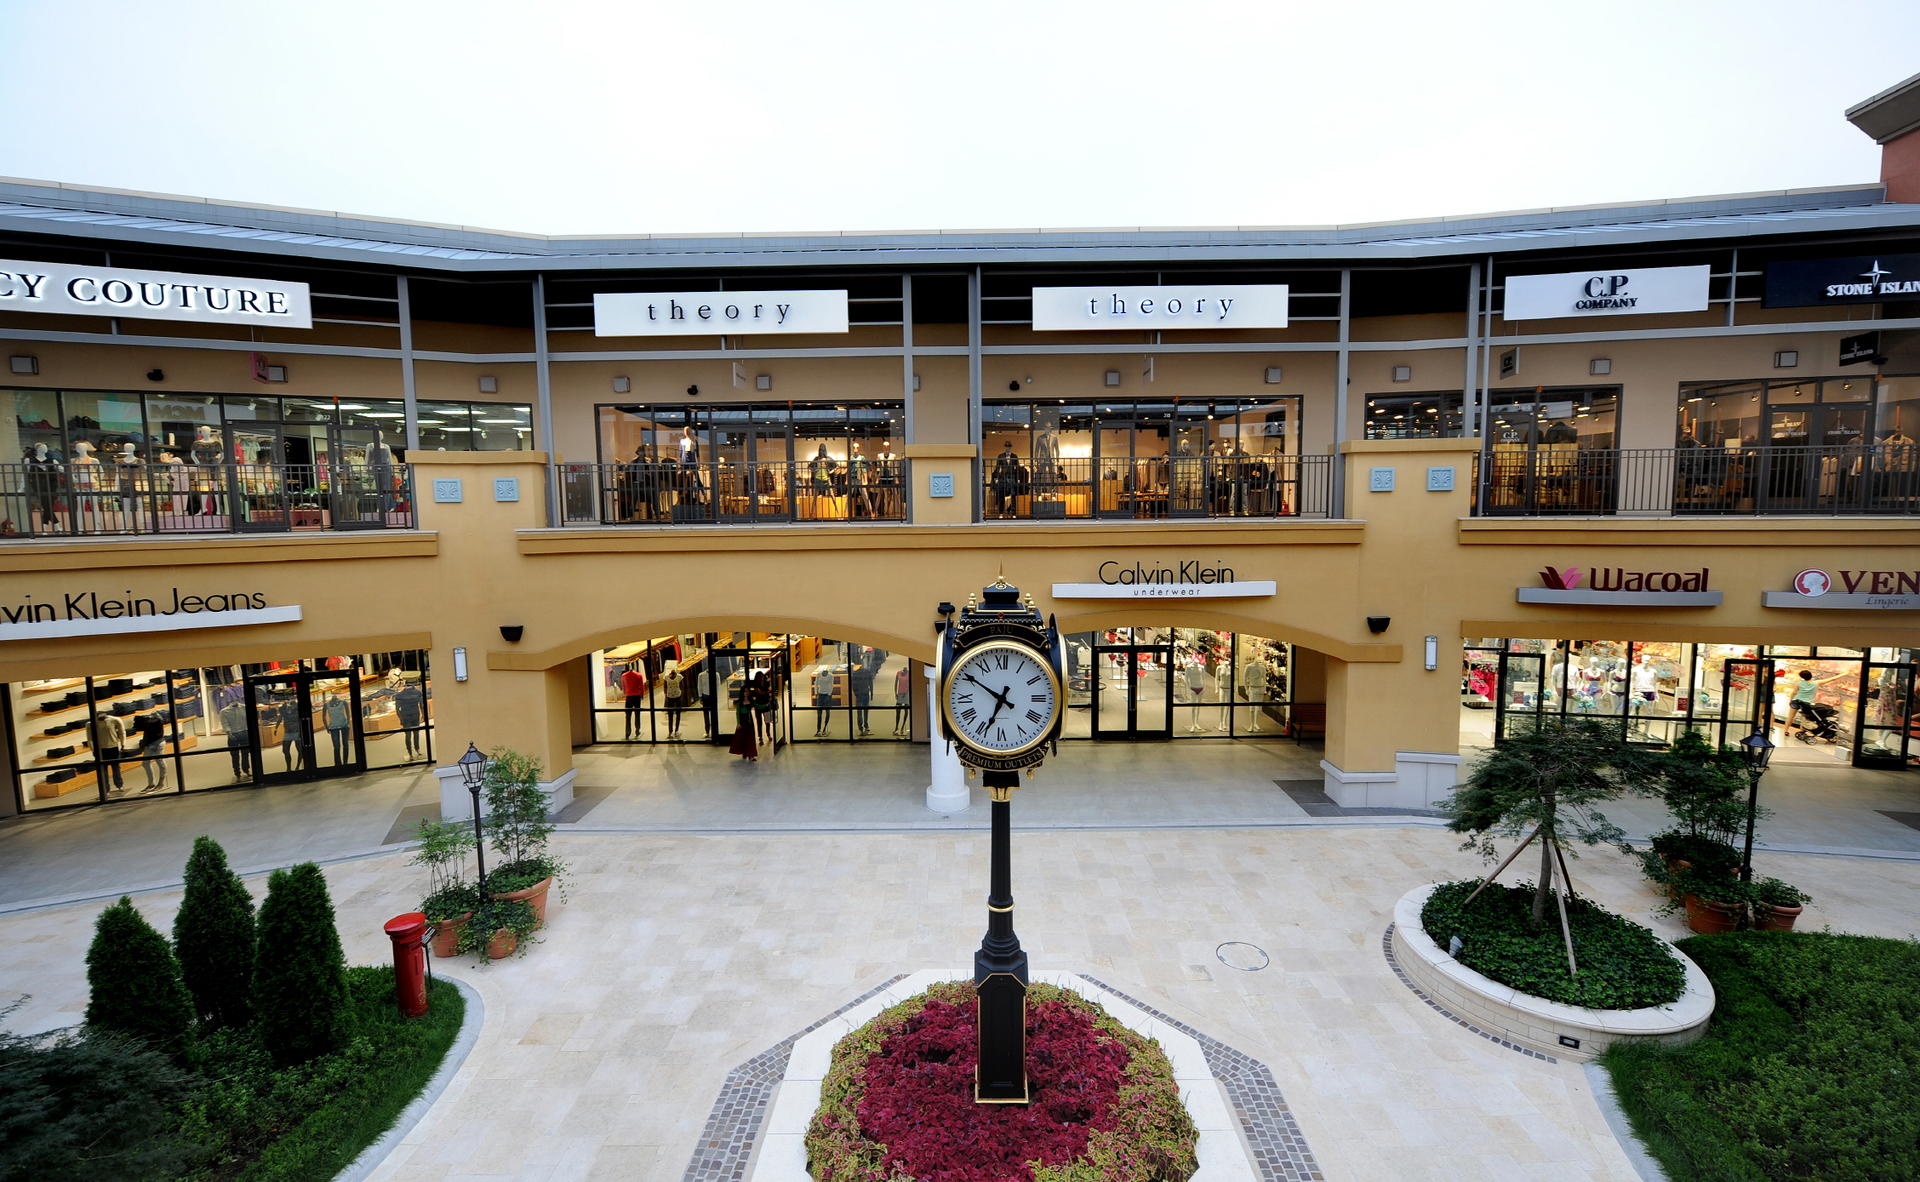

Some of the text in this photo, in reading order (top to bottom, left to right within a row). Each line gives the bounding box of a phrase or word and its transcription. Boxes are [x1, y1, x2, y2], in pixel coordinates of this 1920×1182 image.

[67, 277, 289, 314] COUTURE
[1584, 275, 1629, 298] C.P.
[1826, 283, 1873, 297] STONE
[648, 299, 791, 324] theory
[1090, 293, 1234, 320] theory
[1575, 297, 1638, 310] COMPANY
[1098, 560, 1234, 585] Calvin Klein
[1589, 567, 1709, 593] Wacoal
[1837, 570, 1920, 595] VEN
[1133, 587, 1201, 596] underwear
[1865, 596, 1909, 609] Lingerie
[0, 587, 267, 624] vin Klein Jeans
[990, 625, 1014, 634] PAJU
[961, 751, 1042, 769] PREMIUM OUTLETS
